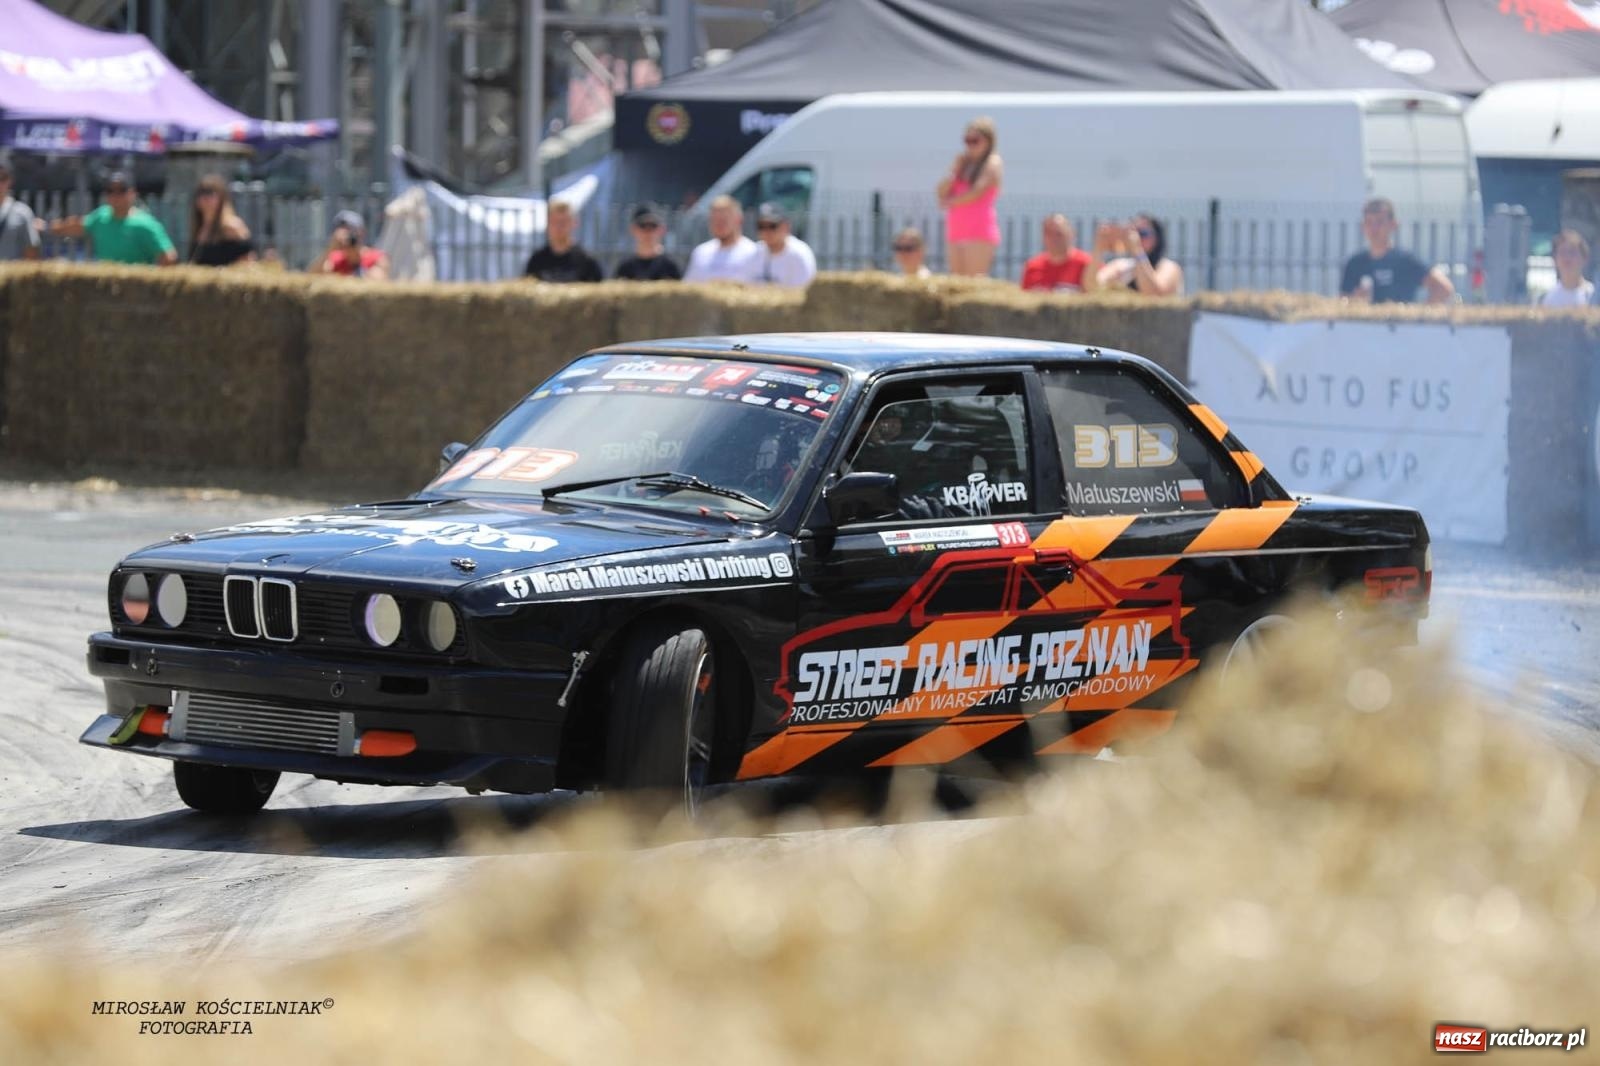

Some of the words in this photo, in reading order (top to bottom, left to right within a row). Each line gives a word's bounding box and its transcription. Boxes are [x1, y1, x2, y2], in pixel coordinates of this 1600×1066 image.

[1256, 375, 1364, 408] AUTO
[1388, 378, 1452, 412] FUS
[1074, 423, 1179, 468] 313
[1290, 446, 1418, 483] GROUP
[1067, 480, 1180, 504] Matuszewski
[1001, 524, 1026, 545] 313
[529, 567, 596, 594] Marek
[592, 559, 706, 588] Matuszewski
[703, 555, 771, 579] Drifting
[793, 646, 909, 702] STREET
[912, 634, 1023, 693] RACING
[1025, 619, 1152, 683] POZNAŃ
[788, 694, 925, 723] PROFESJONALNY
[929, 687, 1018, 711] WARSZTAT
[1020, 674, 1156, 702] SAMOCHODOWY
